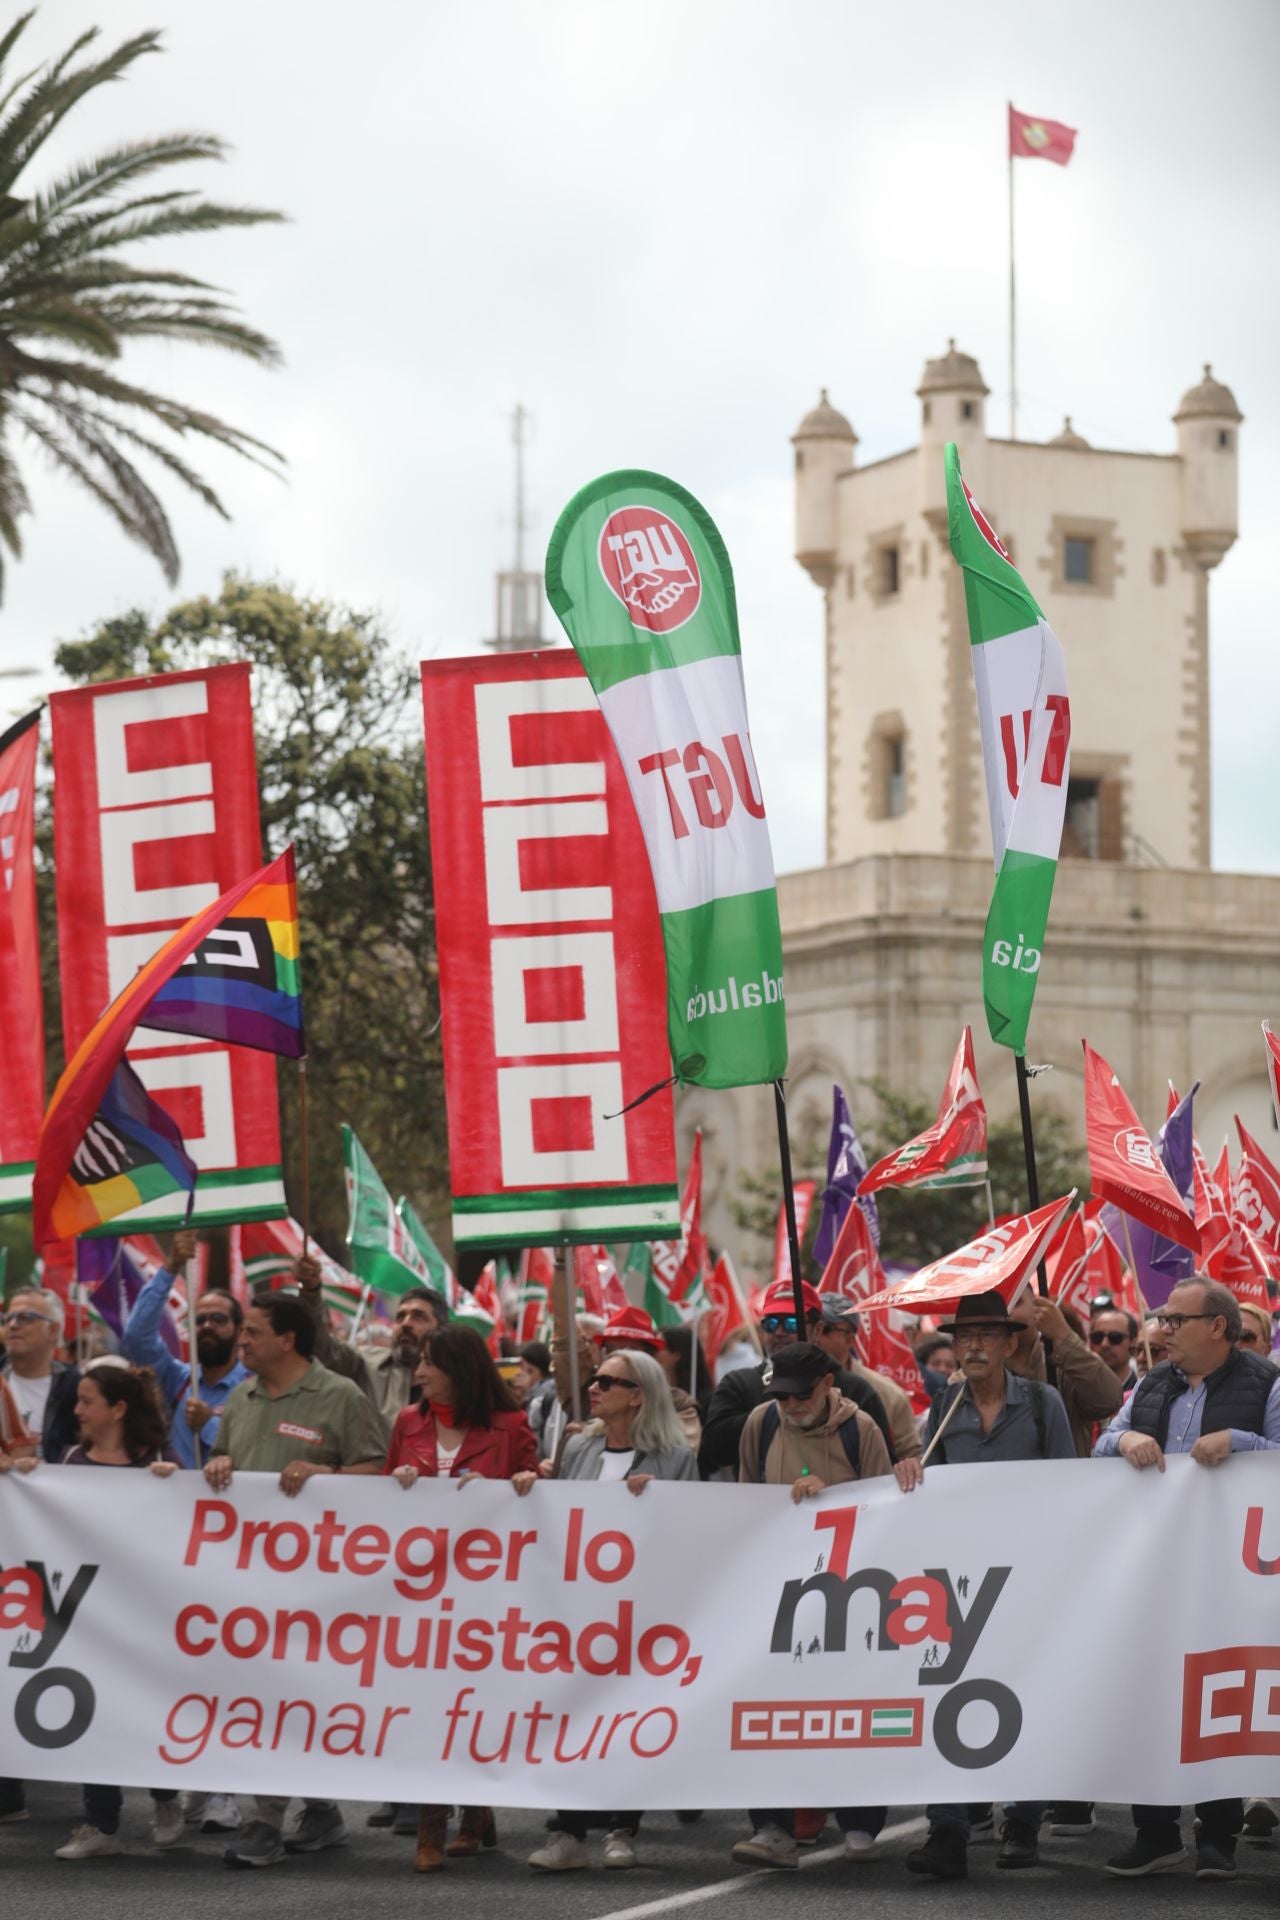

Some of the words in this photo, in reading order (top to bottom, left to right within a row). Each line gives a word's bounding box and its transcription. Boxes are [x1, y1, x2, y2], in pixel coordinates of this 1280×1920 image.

[474, 676, 628, 1187] CCOO
[184, 1499, 536, 1601] Proteger
[563, 1508, 635, 1584] lo
[174, 1598, 703, 1687] conquistado,
[158, 1692, 410, 1765] ganar
[441, 1687, 680, 1764] futuro
[740, 1709, 862, 1742] CCOO
